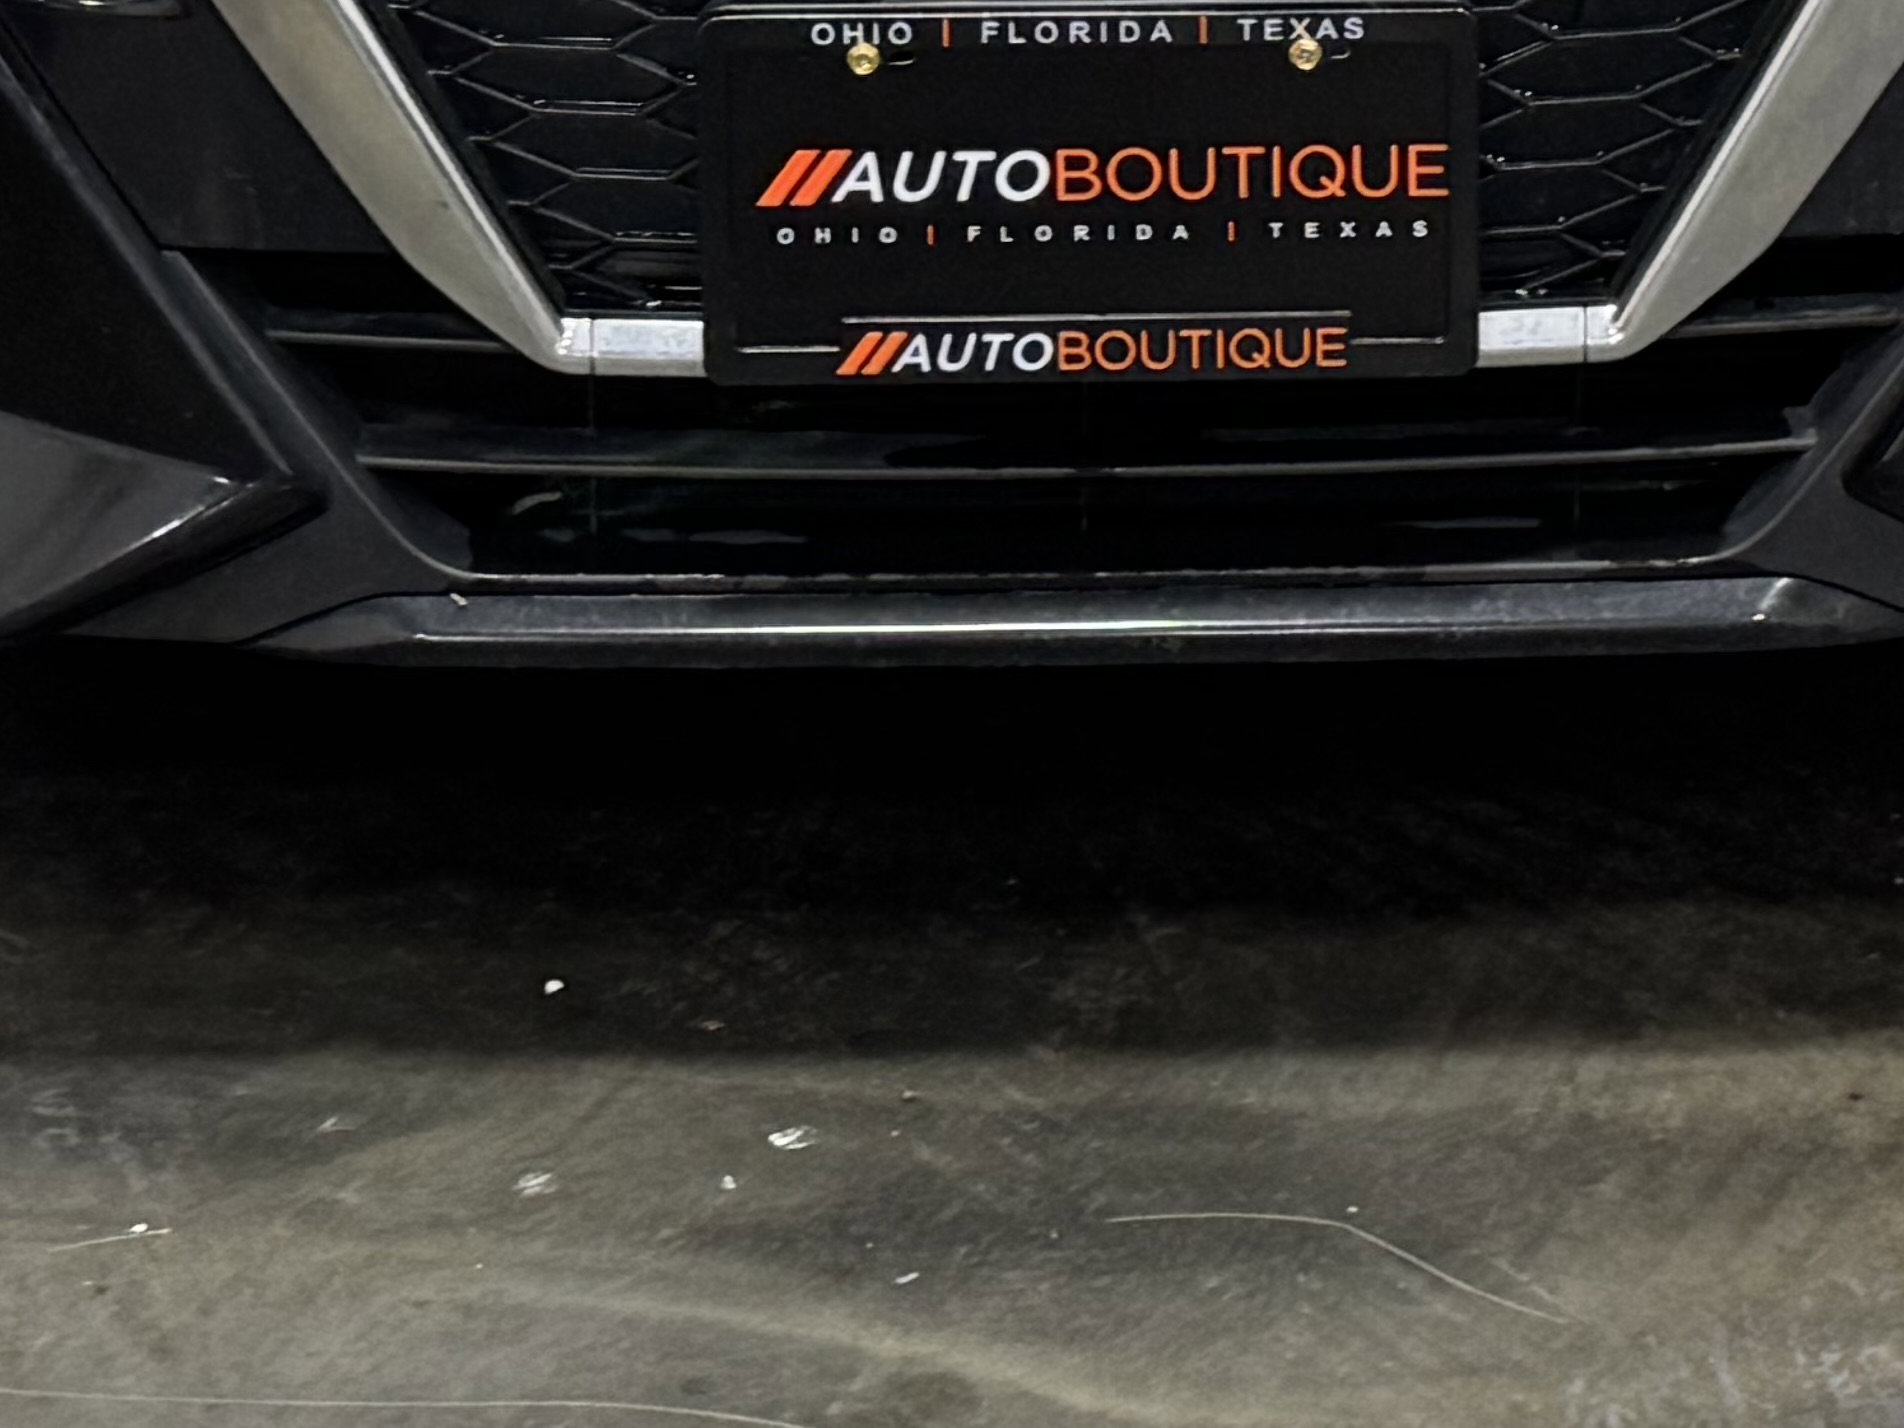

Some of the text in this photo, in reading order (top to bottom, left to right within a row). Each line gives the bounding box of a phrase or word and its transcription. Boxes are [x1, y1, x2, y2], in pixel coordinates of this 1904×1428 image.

[810, 17, 1365, 46] OHIO FLORIDA TEXAS
[832, 144, 1450, 203] AUTOBOUTIQUE
[776, 221, 1431, 245] OHIO FLORIDA TEXAS
[890, 327, 1348, 373] AUTOBOUTIQUE
